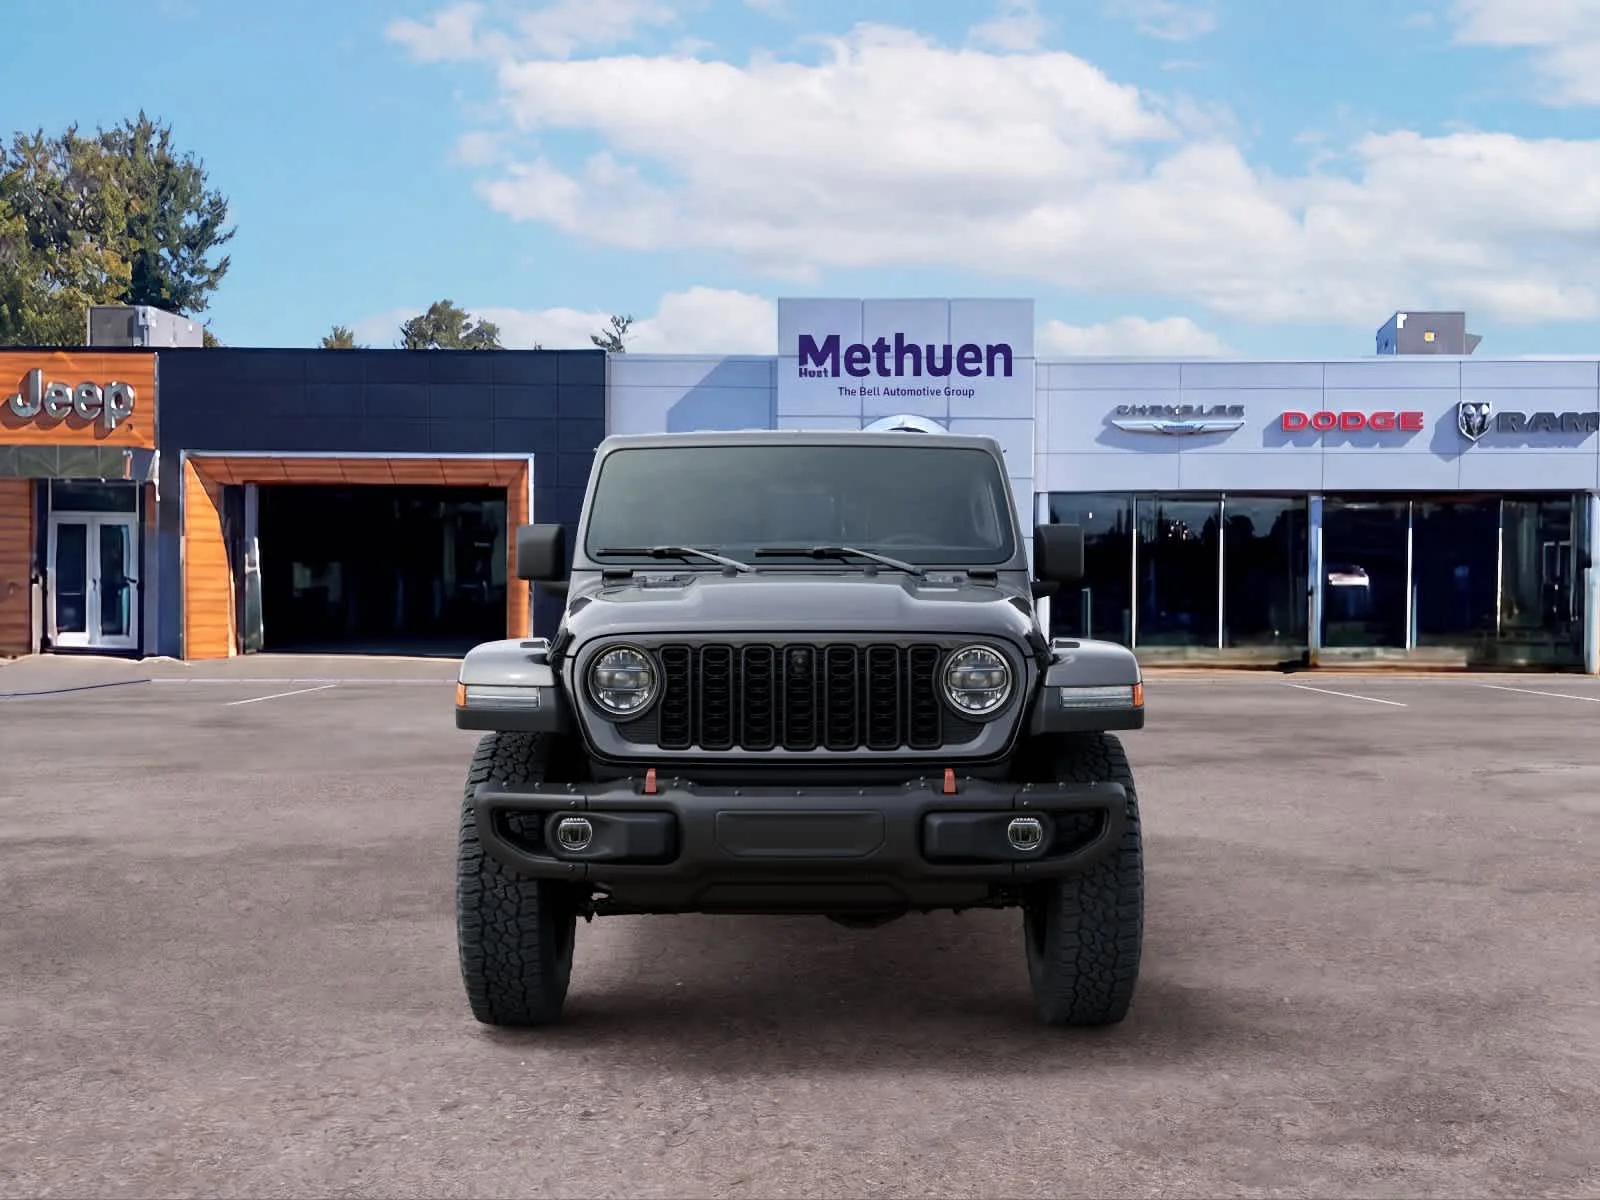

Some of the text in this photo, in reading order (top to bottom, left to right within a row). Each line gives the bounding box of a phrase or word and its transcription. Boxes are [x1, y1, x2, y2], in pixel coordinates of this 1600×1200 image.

[798, 333, 1013, 377] Methuen
[9, 368, 135, 431] Jeep
[838, 386, 975, 399] The Bell Automotive Group
[1282, 411, 1424, 431] DODGE
[1497, 411, 1599, 432] RAM
